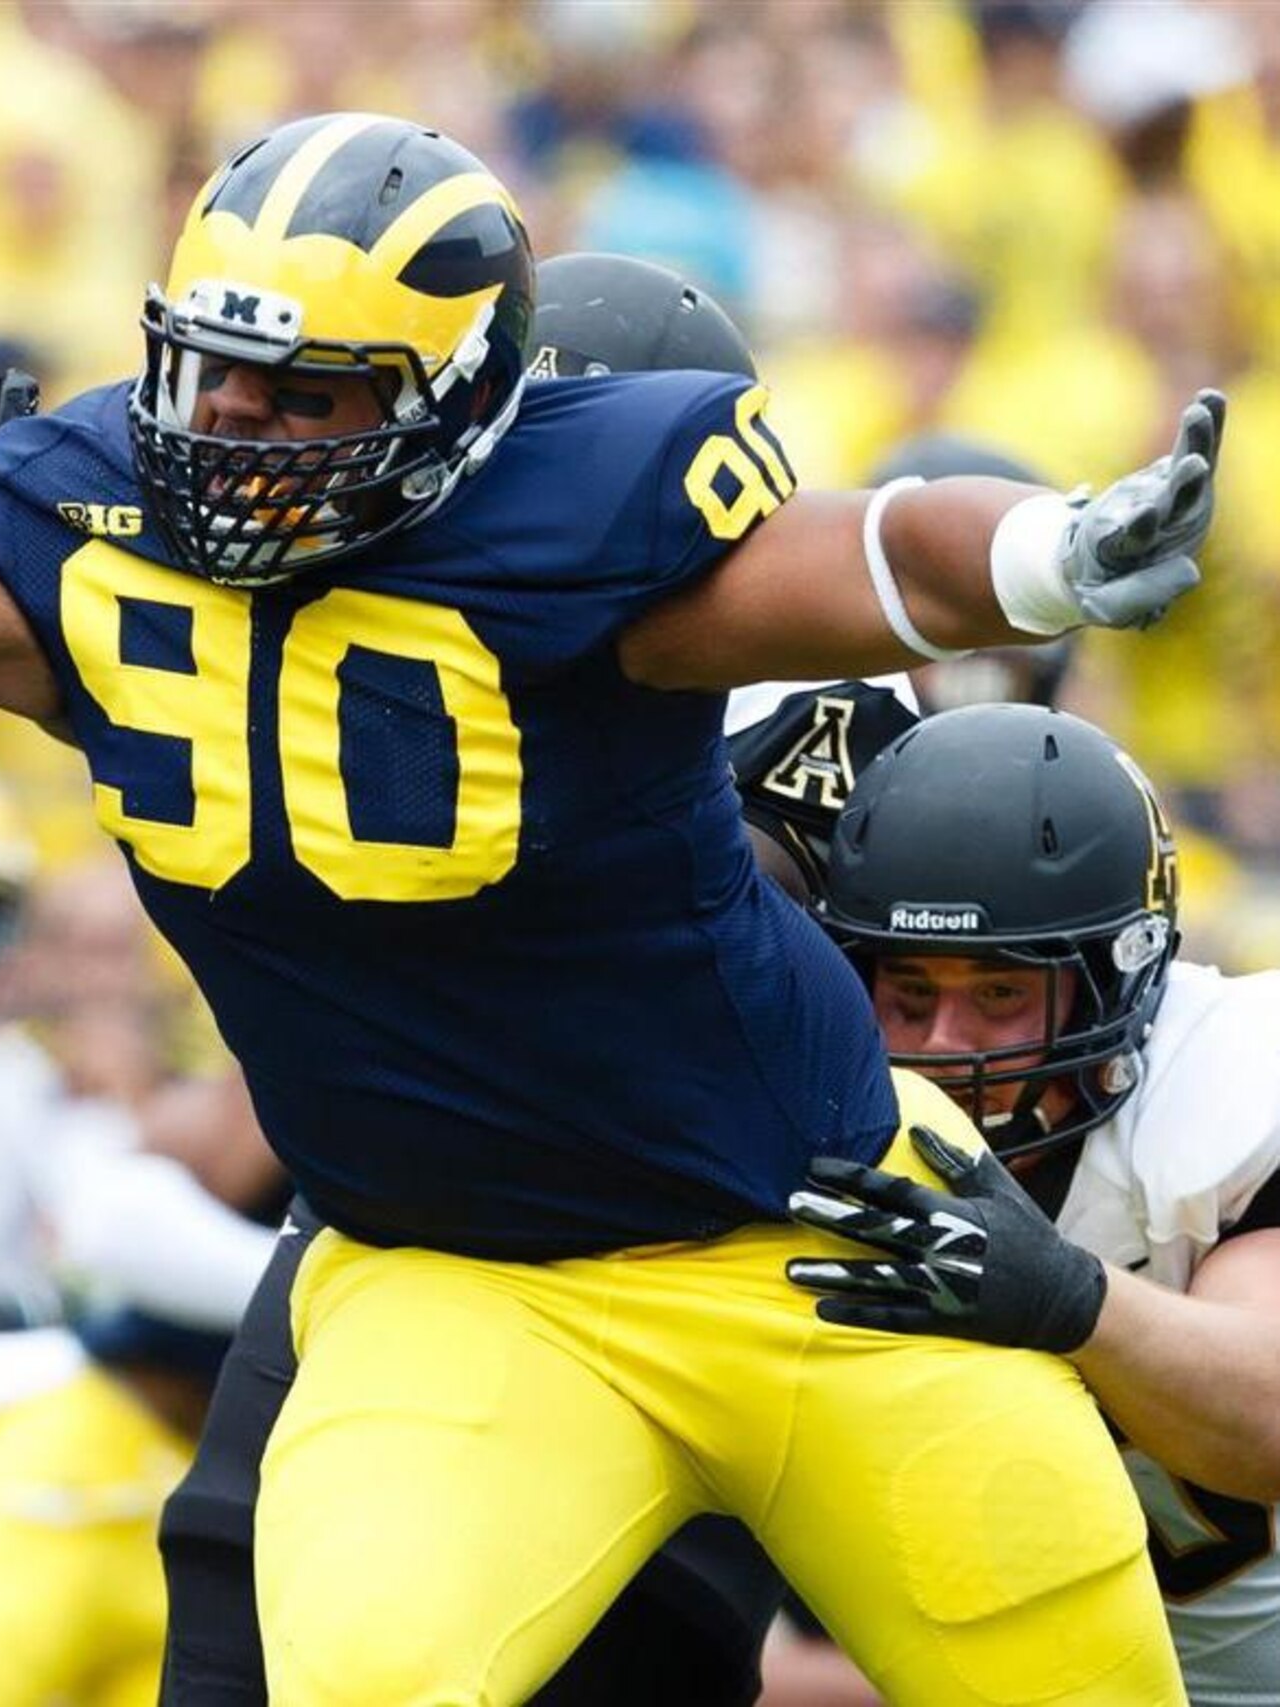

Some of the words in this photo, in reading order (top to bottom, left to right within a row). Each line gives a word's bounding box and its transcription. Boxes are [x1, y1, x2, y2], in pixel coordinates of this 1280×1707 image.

[221, 289, 260, 324] M
[60, 537, 524, 902] 90
[761, 696, 856, 810] A
[890, 908, 979, 930] Riddell
